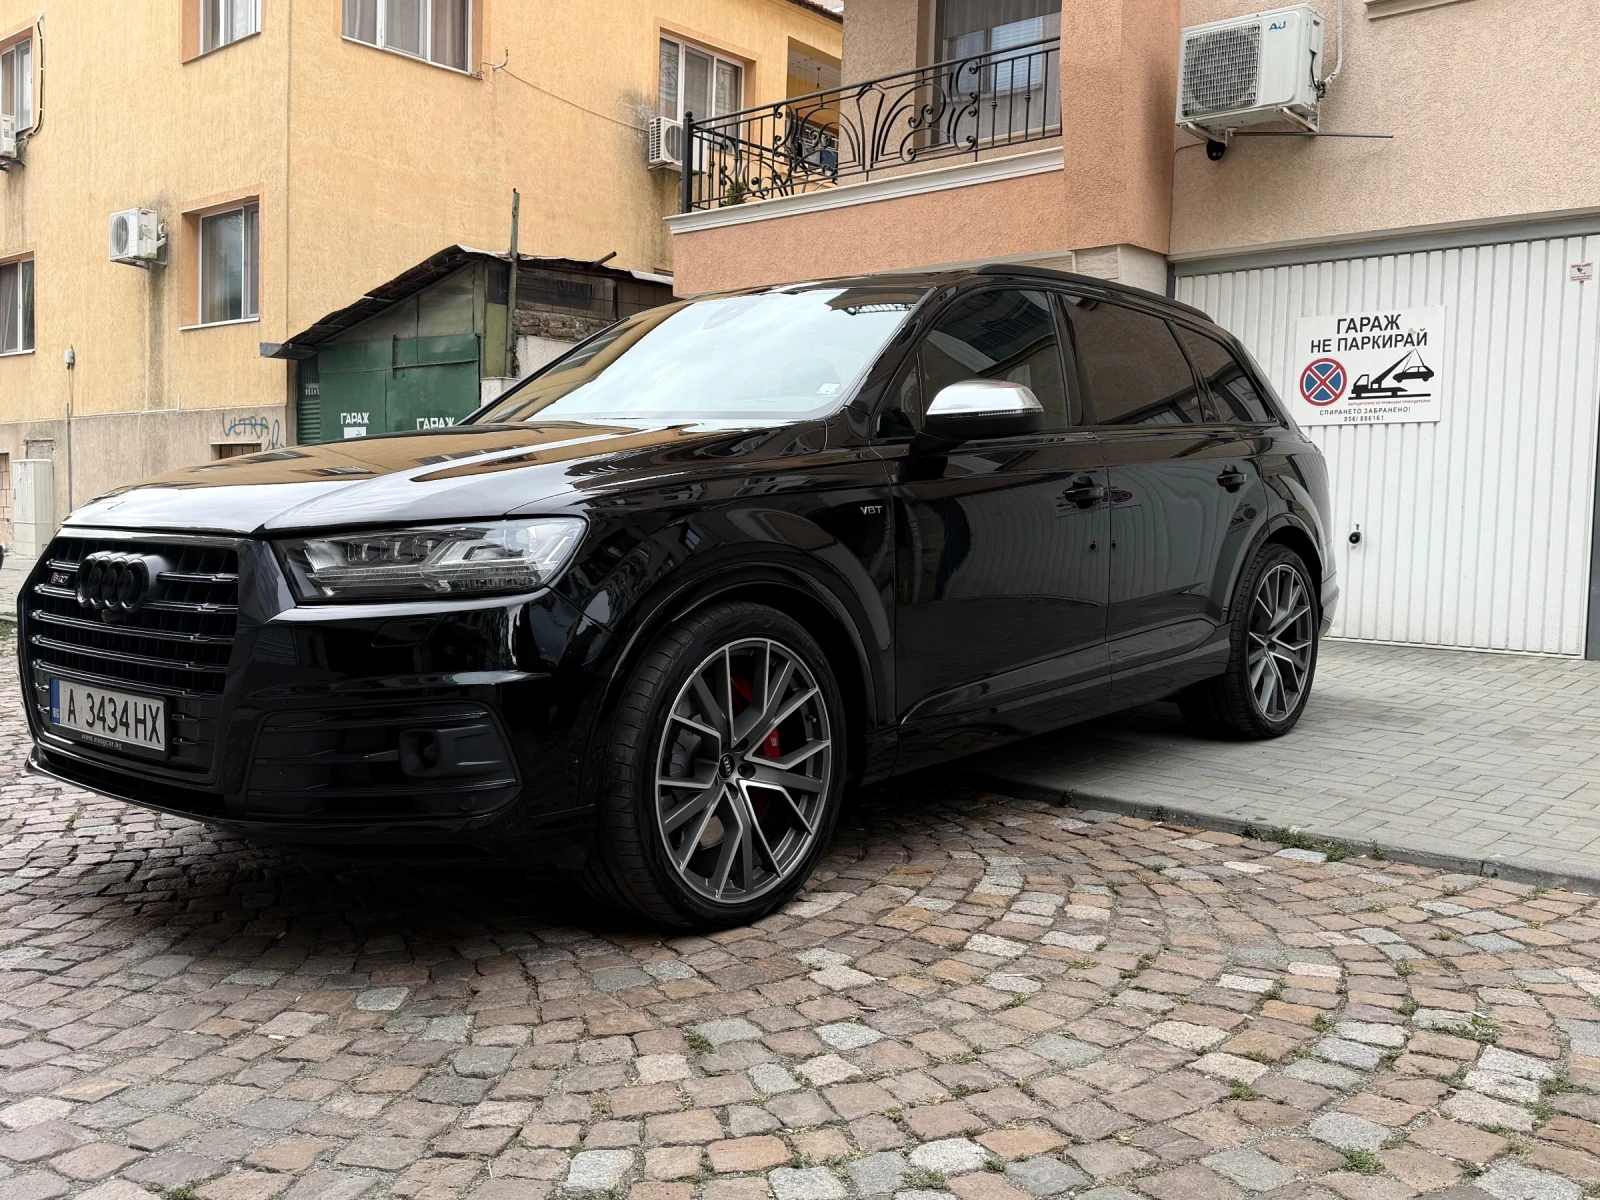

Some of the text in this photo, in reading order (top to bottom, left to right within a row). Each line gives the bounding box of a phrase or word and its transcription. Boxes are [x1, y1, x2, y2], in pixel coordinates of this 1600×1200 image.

[1337, 314, 1401, 334] ГАРАЖ
[1311, 328, 1428, 353] НЕ ПАРКИРАЙ
[340, 412, 369, 424] ГАРАЖ
[1319, 406, 1411, 416] СПИРАНЕТО ЗАБРАНЕНО!
[416, 417, 455, 430] ГАРАЖ
[67, 688, 77, 724] A
